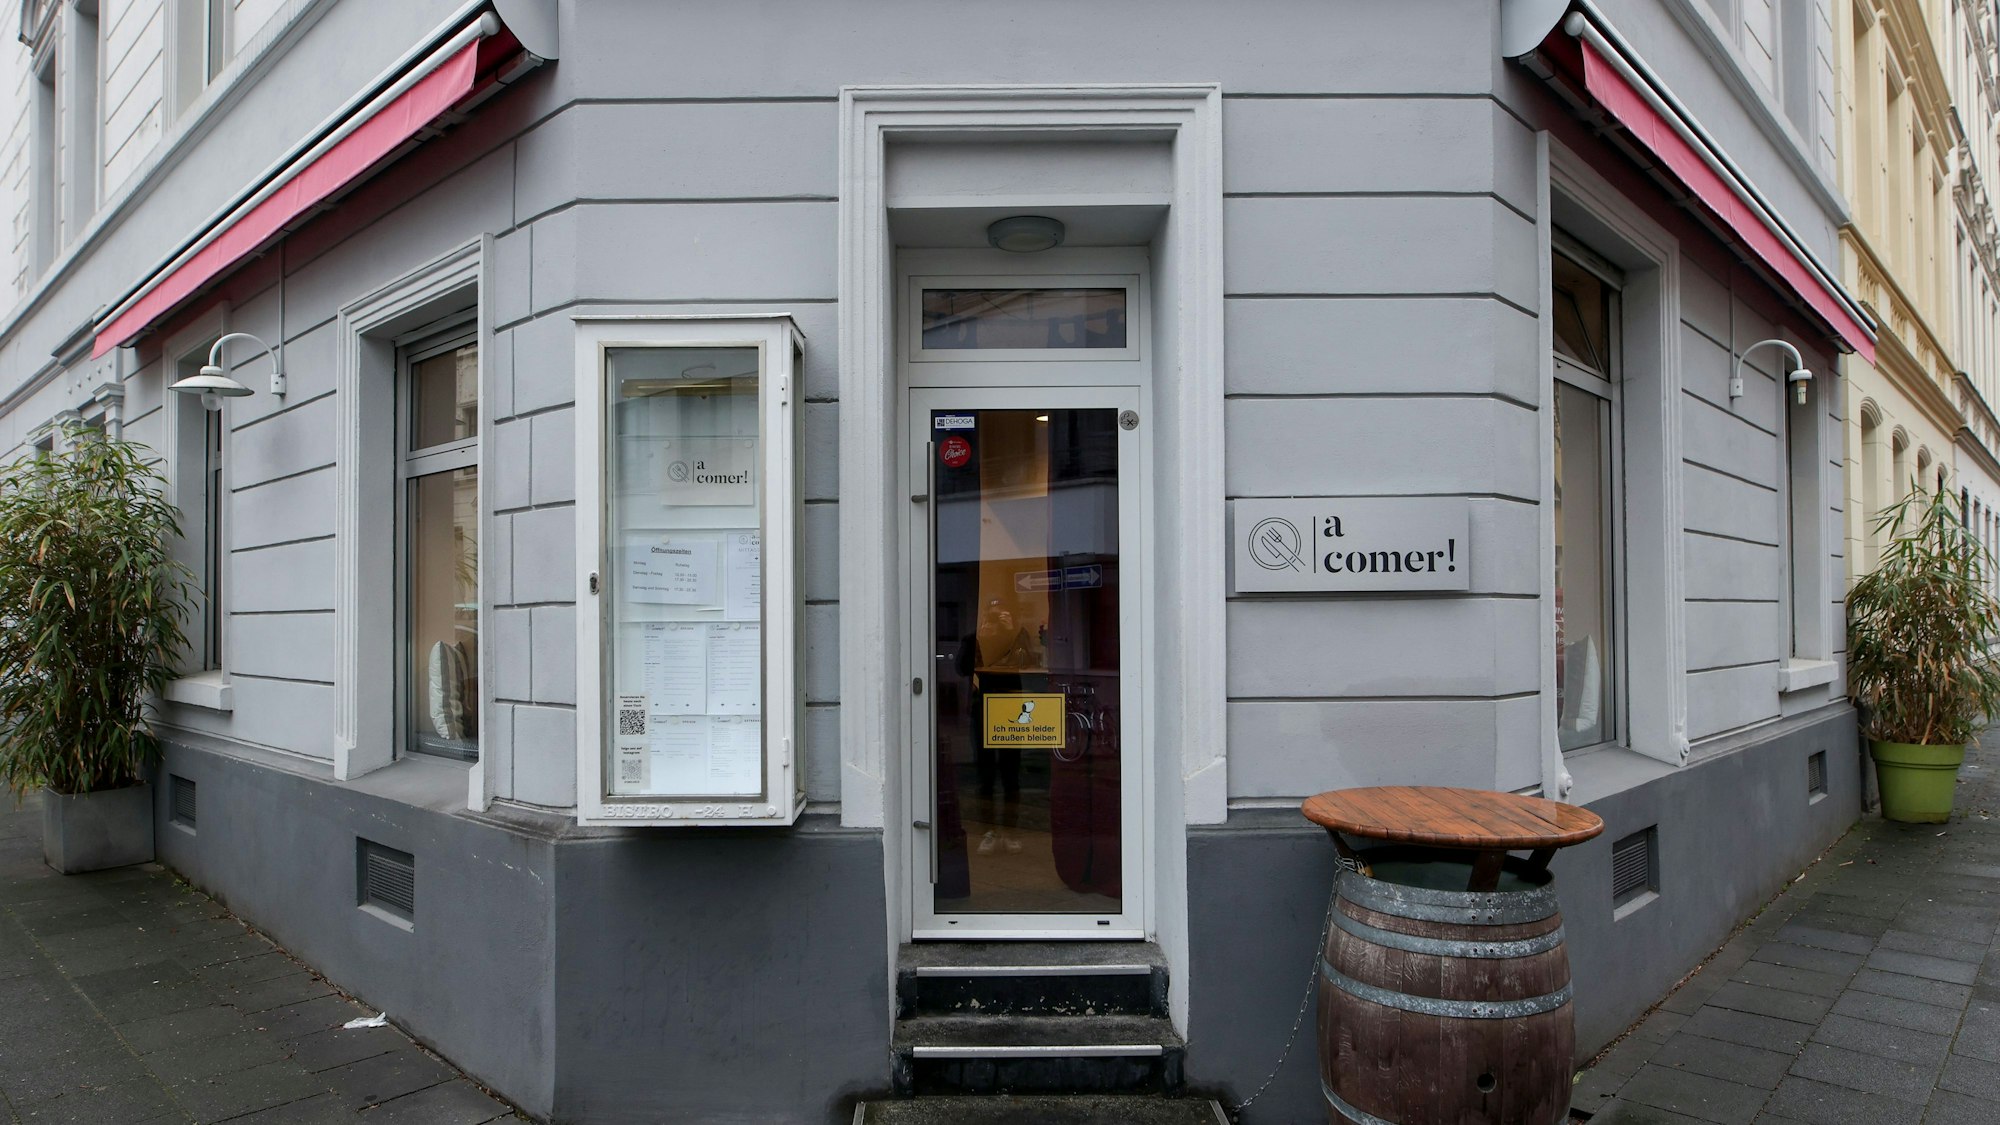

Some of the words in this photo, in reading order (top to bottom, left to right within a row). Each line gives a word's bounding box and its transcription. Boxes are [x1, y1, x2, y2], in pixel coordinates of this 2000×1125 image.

[696, 460, 706, 470] a
[696, 470, 748, 484] comer!
[1323, 515, 1345, 538] a
[1323, 538, 1456, 573] comer!
[993, 725, 1006, 733] Ich
[1032, 725, 1056, 733] leider
[991, 734, 1025, 742] draußen
[602, 804, 674, 819] BISTRO
